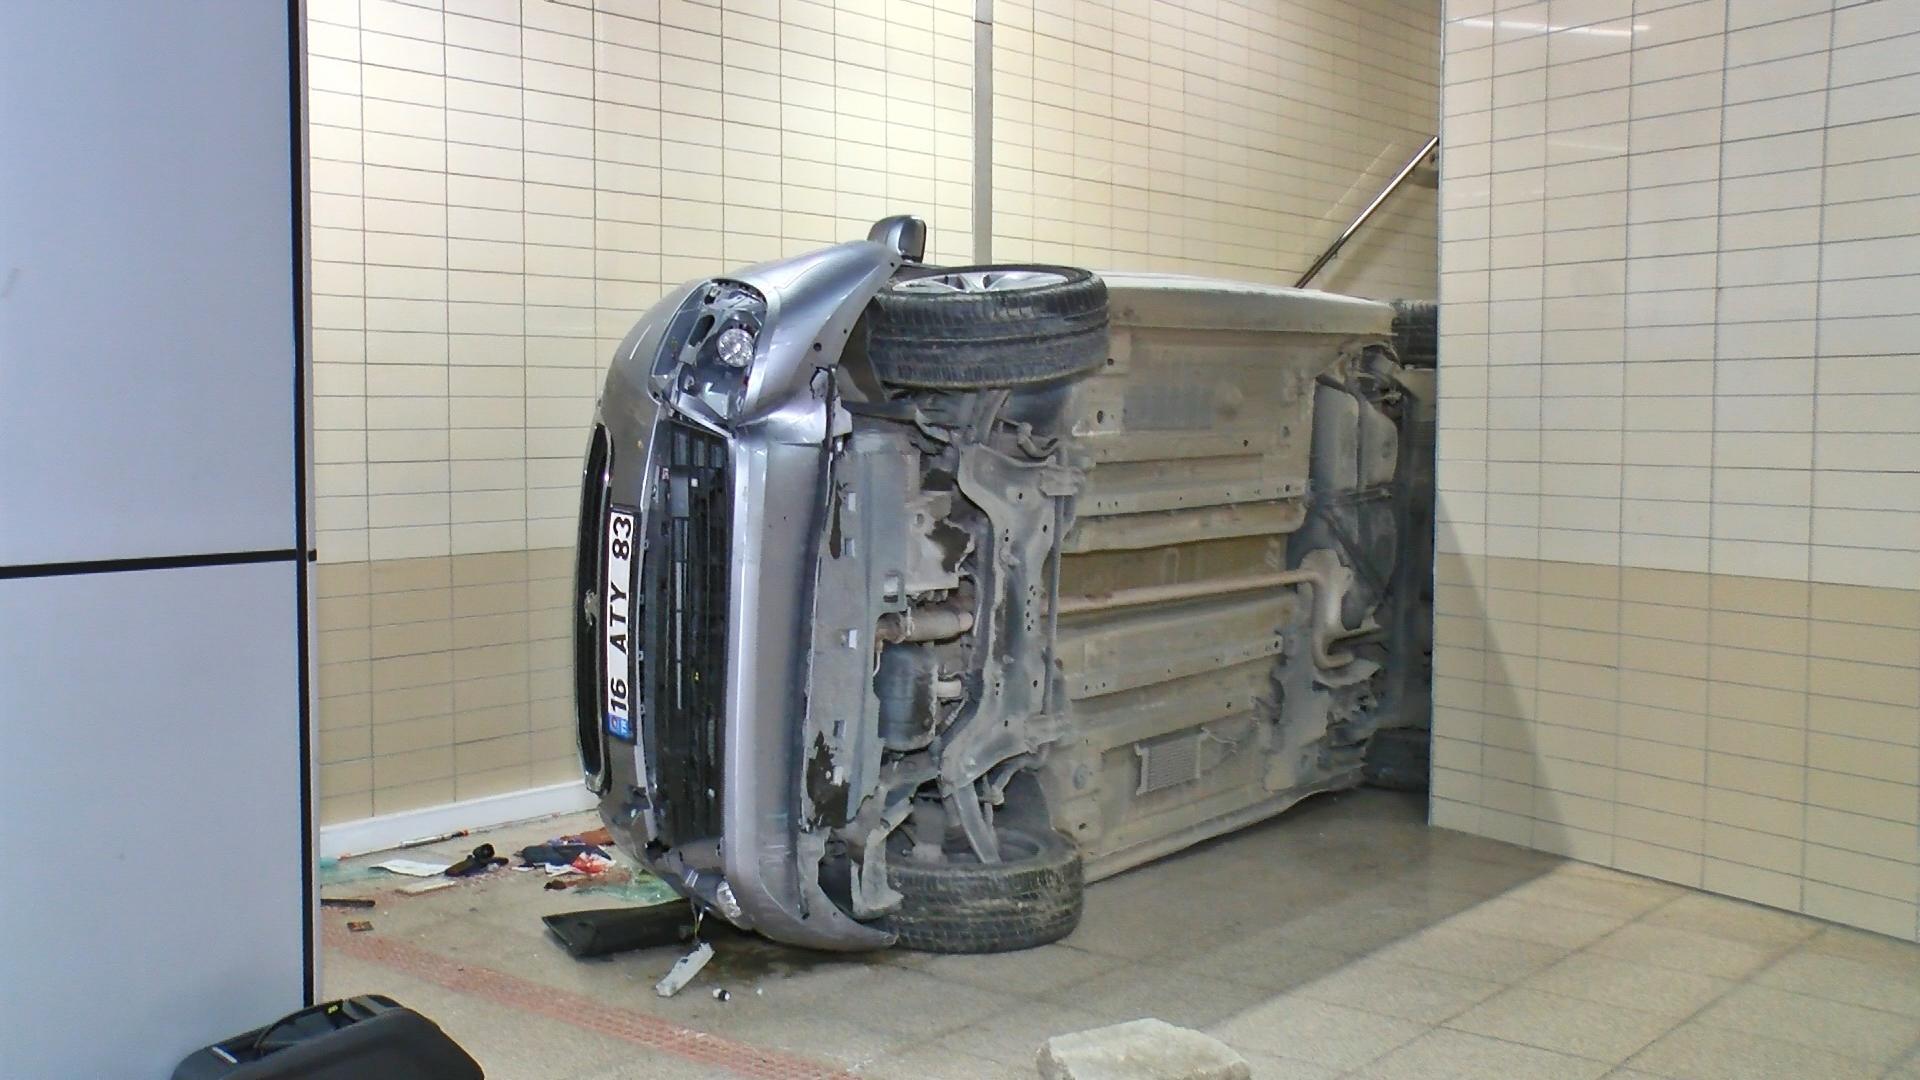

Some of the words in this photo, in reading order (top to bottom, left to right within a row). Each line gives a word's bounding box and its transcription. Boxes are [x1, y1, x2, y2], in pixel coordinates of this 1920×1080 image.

[612, 516, 631, 560] 83
[610, 581, 627, 655] ATY
[610, 677, 627, 711] 16
